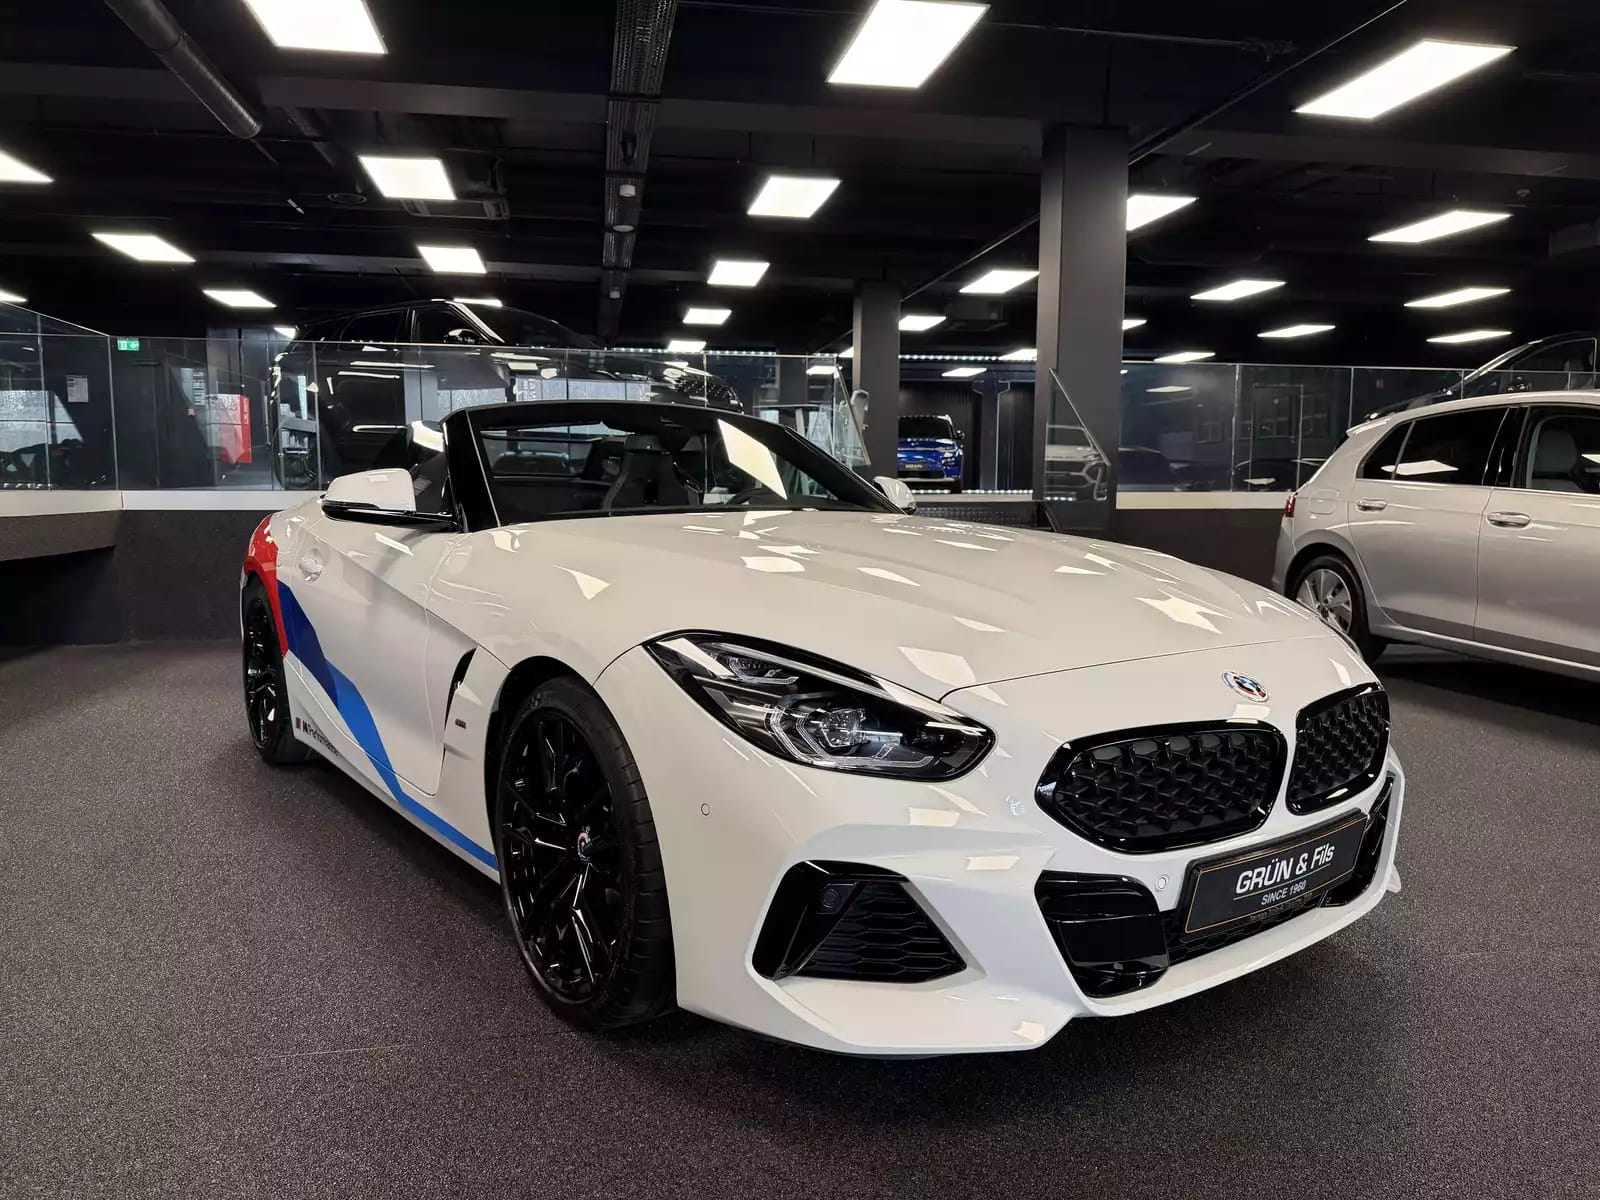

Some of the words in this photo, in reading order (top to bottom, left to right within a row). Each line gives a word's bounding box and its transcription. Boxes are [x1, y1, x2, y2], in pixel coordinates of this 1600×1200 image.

[1236, 858, 1294, 893] GRÜN
[1295, 852, 1309, 875] &
[1310, 842, 1335, 869] Fils
[1261, 888, 1288, 906] SINCE
[1289, 880, 1307, 895] 1960
